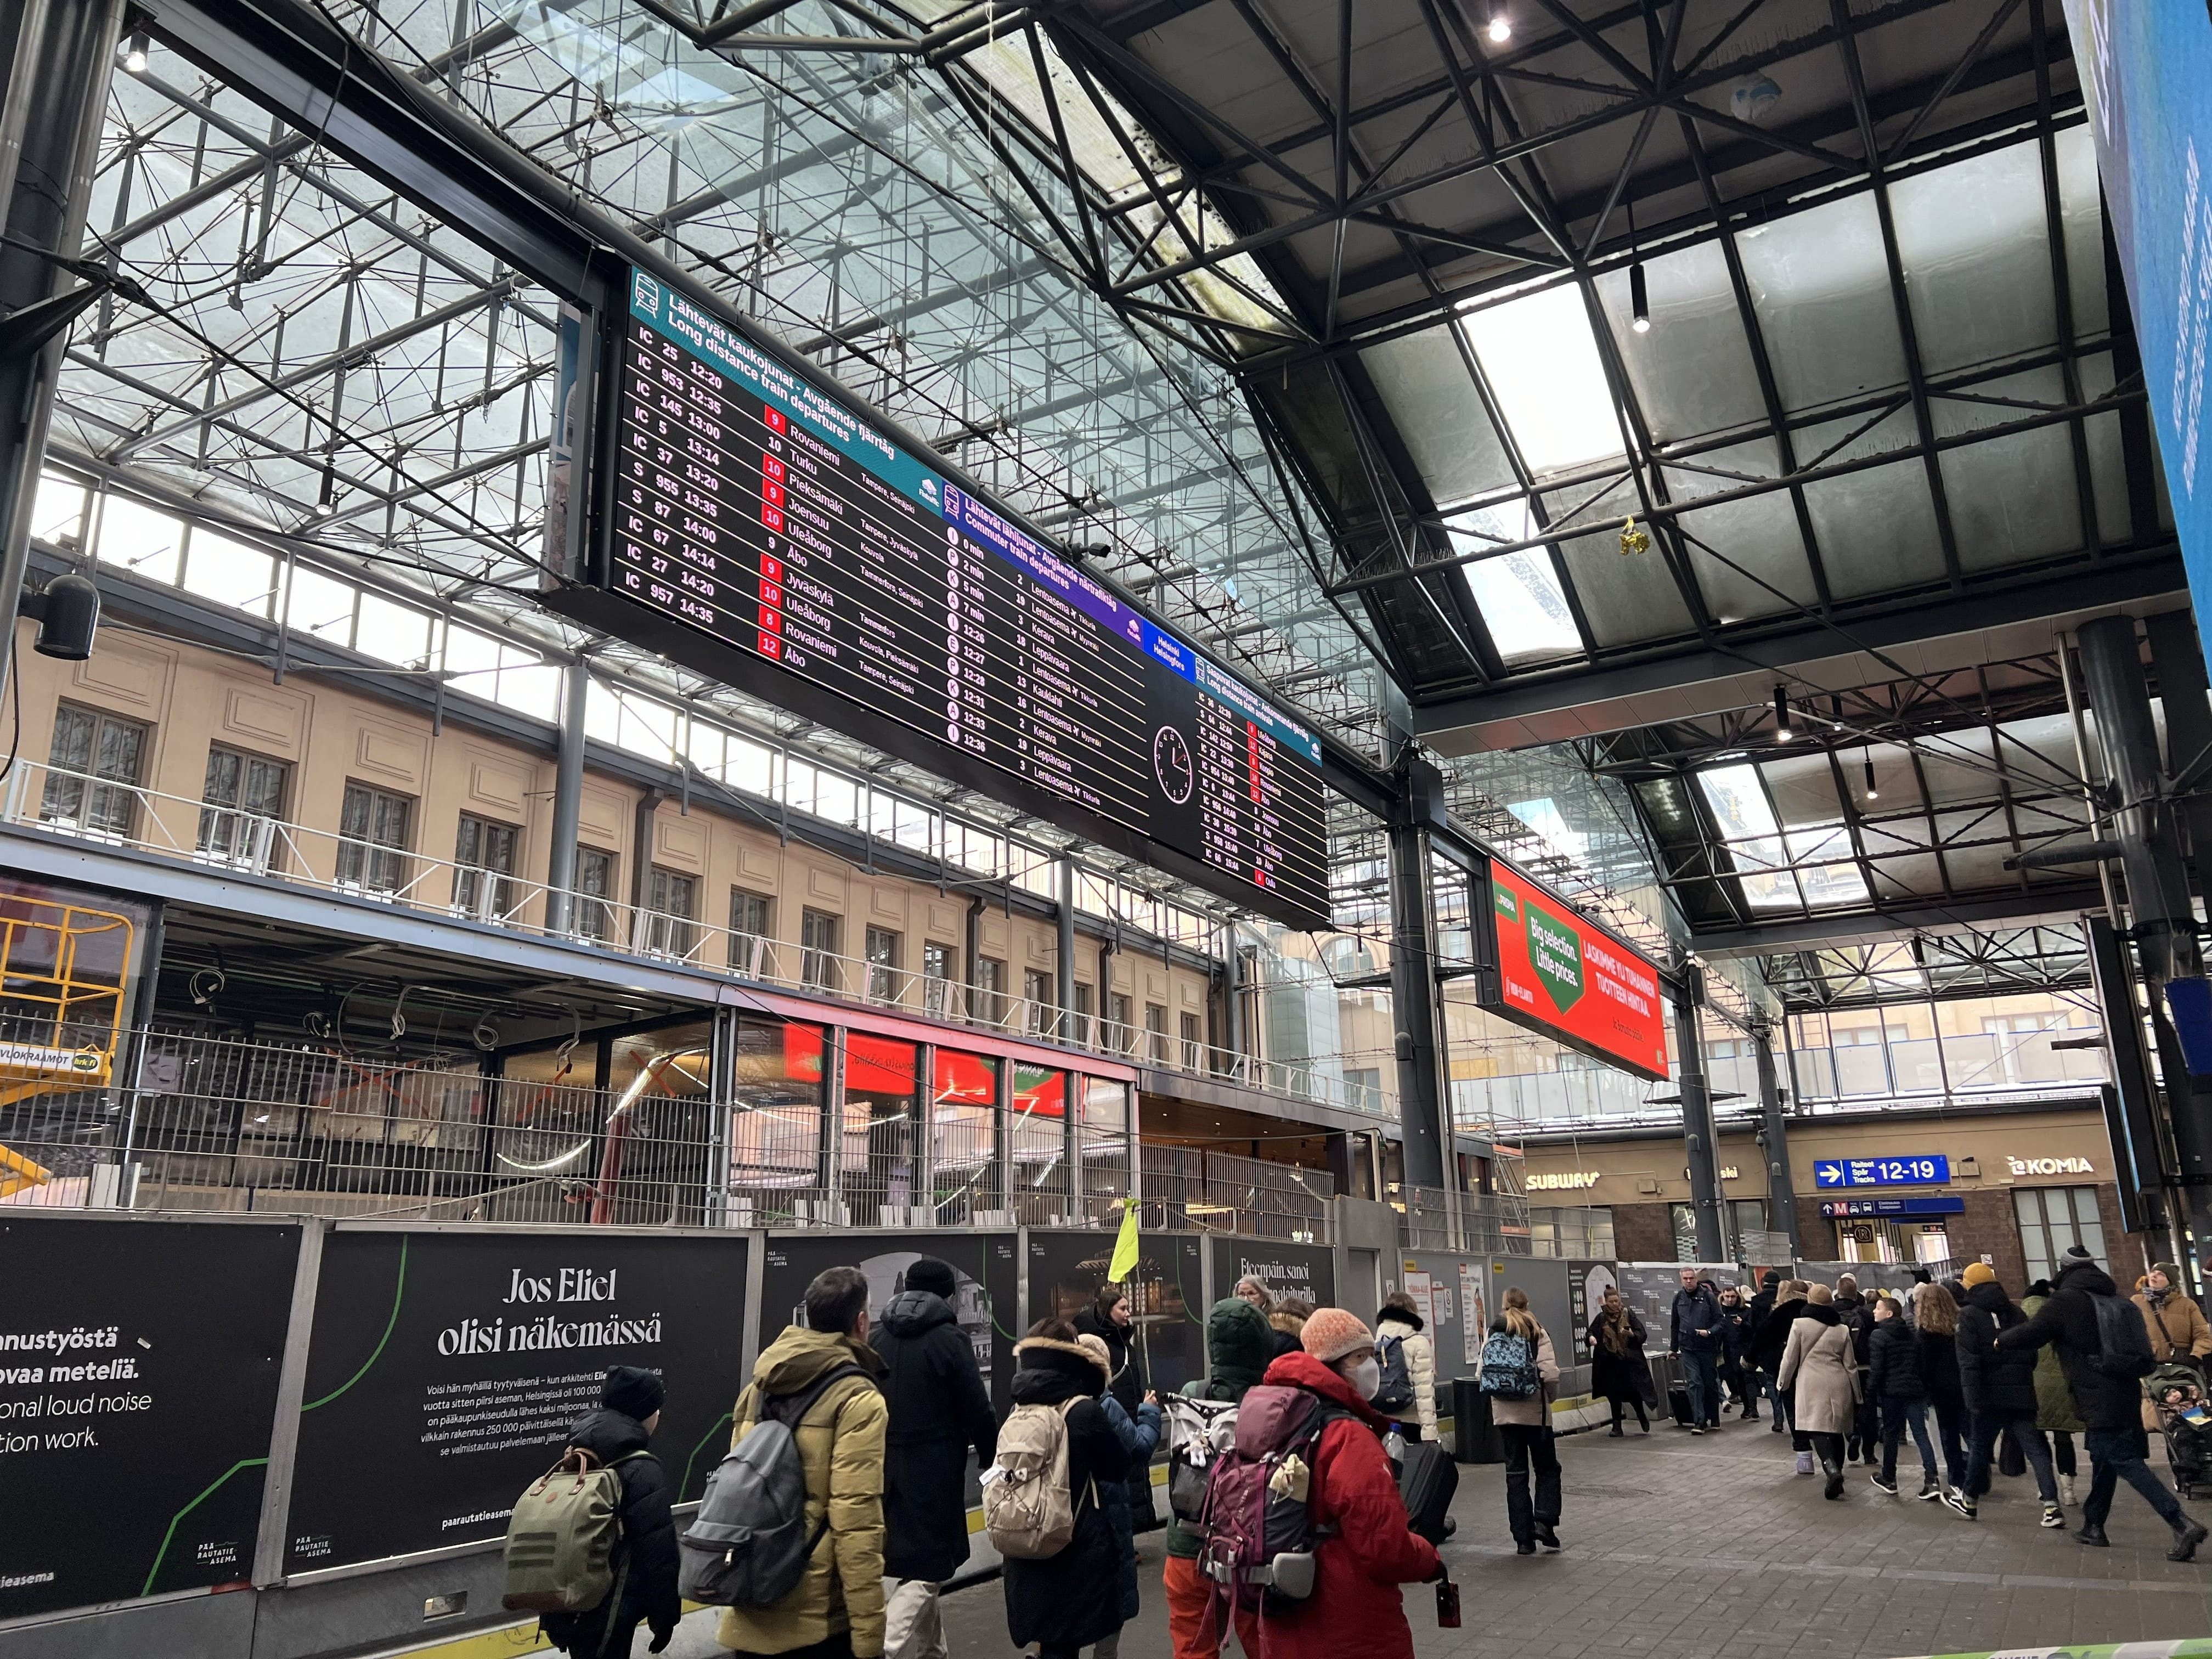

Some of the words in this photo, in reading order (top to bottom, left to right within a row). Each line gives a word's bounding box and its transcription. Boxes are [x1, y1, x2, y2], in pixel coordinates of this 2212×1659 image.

[639, 326, 653, 345] IC
[662, 342, 678, 360] 25
[690, 360, 722, 390] 12:20
[771, 413, 778, 426] 9
[790, 424, 840, 466] Rovaniemi
[668, 310, 702, 347] Long
[705, 337, 758, 381] distance
[760, 370, 788, 401] train
[790, 394, 849, 442] departures
[669, 293, 726, 342] Lähtevät
[727, 332, 794, 390] kaukojunat
[802, 387, 856, 431] Avgående
[857, 422, 894, 460] fjärrtåg
[637, 352, 651, 370] IC
[661, 368, 684, 391] 953
[689, 386, 721, 414] 12:35
[768, 436, 781, 452] 10
[789, 448, 817, 476] Turku
[636, 379, 650, 397] IC
[659, 394, 682, 417] 145
[687, 411, 720, 439] 13:00
[766, 460, 781, 476] 10
[789, 472, 843, 515] Pieksämäki
[634, 405, 649, 424] IC
[658, 419, 667, 435] 5
[686, 437, 720, 466] 13:14
[769, 486, 777, 499] 9
[788, 497, 829, 531] Joensuu
[633, 432, 647, 450] IC
[657, 447, 673, 464] 37
[685, 464, 718, 491] 13:20
[766, 510, 780, 526] 10
[788, 521, 832, 558] Uleåborg
[633, 461, 644, 476] S
[655, 473, 679, 496] 955
[684, 490, 717, 517] 13:35
[768, 535, 775, 549] 9
[786, 544, 808, 567] Åbo
[631, 489, 642, 504] S
[654, 500, 670, 518] 87
[683, 516, 716, 543] 14:00
[767, 561, 775, 574] 9
[786, 571, 834, 607] Jyväskylä
[964, 512, 1008, 549] Commuter
[1009, 541, 1028, 562] train
[1029, 556, 1069, 589] departures
[964, 497, 1001, 531] Lähtevät
[1002, 522, 1036, 555] lähijunat
[1042, 551, 1077, 583] Avgående
[1079, 577, 1116, 612] närtrafiktåg
[628, 515, 643, 533] IC
[653, 528, 669, 545] 67
[681, 543, 716, 571] 14:14
[764, 585, 777, 601] 10
[786, 596, 831, 631] Uleåborg
[963, 559, 969, 571] 2
[969, 564, 984, 581] min
[1015, 592, 1025, 606] 19
[1031, 602, 1070, 634] Lentoasema
[963, 580, 969, 592] 5
[969, 585, 984, 602] min
[1017, 614, 1023, 625] 3
[1031, 622, 1055, 645] Kerava
[625, 571, 640, 589] IC
[650, 583, 674, 605] 957
[679, 598, 713, 624] 14:35
[762, 637, 776, 653] 12
[784, 645, 805, 667] Åbo
[963, 601, 969, 613] 7
[969, 606, 985, 623] min
[1016, 633, 1026, 647] 18
[1032, 642, 1070, 673] Leppävaara
[1153, 643, 1184, 671] Helsingfors
[1158, 635, 1180, 657] Helsinki
[963, 645, 985, 665] 12:27
[1017, 674, 1026, 688] 13
[1032, 683, 1063, 708] Kauklahti
[1531, 916, 1544, 947] Big
[1544, 929, 1577, 962] selection.
[1583, 939, 1616, 975] LASKIMME
[1536, 946, 1554, 974] Little
[1555, 960, 1578, 987] prices.
[1595, 972, 1627, 1005] TUOTTEEN
[1526, 1172, 1600, 1190] SUBWAY
[1878, 1161, 1934, 1180] 12-19
[1835, 1203, 1847, 1214] M
[502, 1268, 551, 1304] Jos
[557, 1268, 617, 1302] Eliel
[1287, 1262, 1309, 1279] sanoi
[0, 1327, 118, 1356] nustyöstä
[438, 1317, 503, 1356] olisi
[507, 1312, 661, 1351] näkemässä
[49, 1358, 138, 1383] meteliä.
[427, 1385, 445, 1395] Voisi
[462, 1380, 492, 1394] myhäillä
[494, 1377, 539, 1391] tyytyväisenä
[548, 1376, 559, 1384] kun
[561, 1372, 593, 1383] arkkitehti
[47, 1392, 95, 1416] loud
[98, 1391, 152, 1413] noise
[424, 1401, 450, 1411] vuotta
[451, 1399, 475, 1408] sitten
[476, 1396, 493, 1409] piirsi
[494, 1393, 524, 1404] aseman,
[525, 1389, 562, 1401] Helsingissä
[563, 1388, 572, 1397] oli
[573, 1387, 585, 1396] 100
[587, 1386, 601, 1395] 000
[428, 1418, 438, 1426] on
[440, 1407, 517, 1427] pääkaupunkiseudulla
[519, 1407, 537, 1416] lähes
[539, 1404, 555, 1413] kaksi
[557, 1402, 589, 1415] miljoonaa,
[45, 1426, 99, 1449] work.
[421, 1431, 449, 1443] vilkkain
[450, 1428, 485, 1440] rakennus
[487, 1426, 501, 1435] 250
[503, 1423, 518, 1433] 000
[520, 1417, 563, 1431] päivittäisellä
[197, 1548, 234, 1559] RAUTATIE
[210, 1555, 236, 1565] ASEMA
